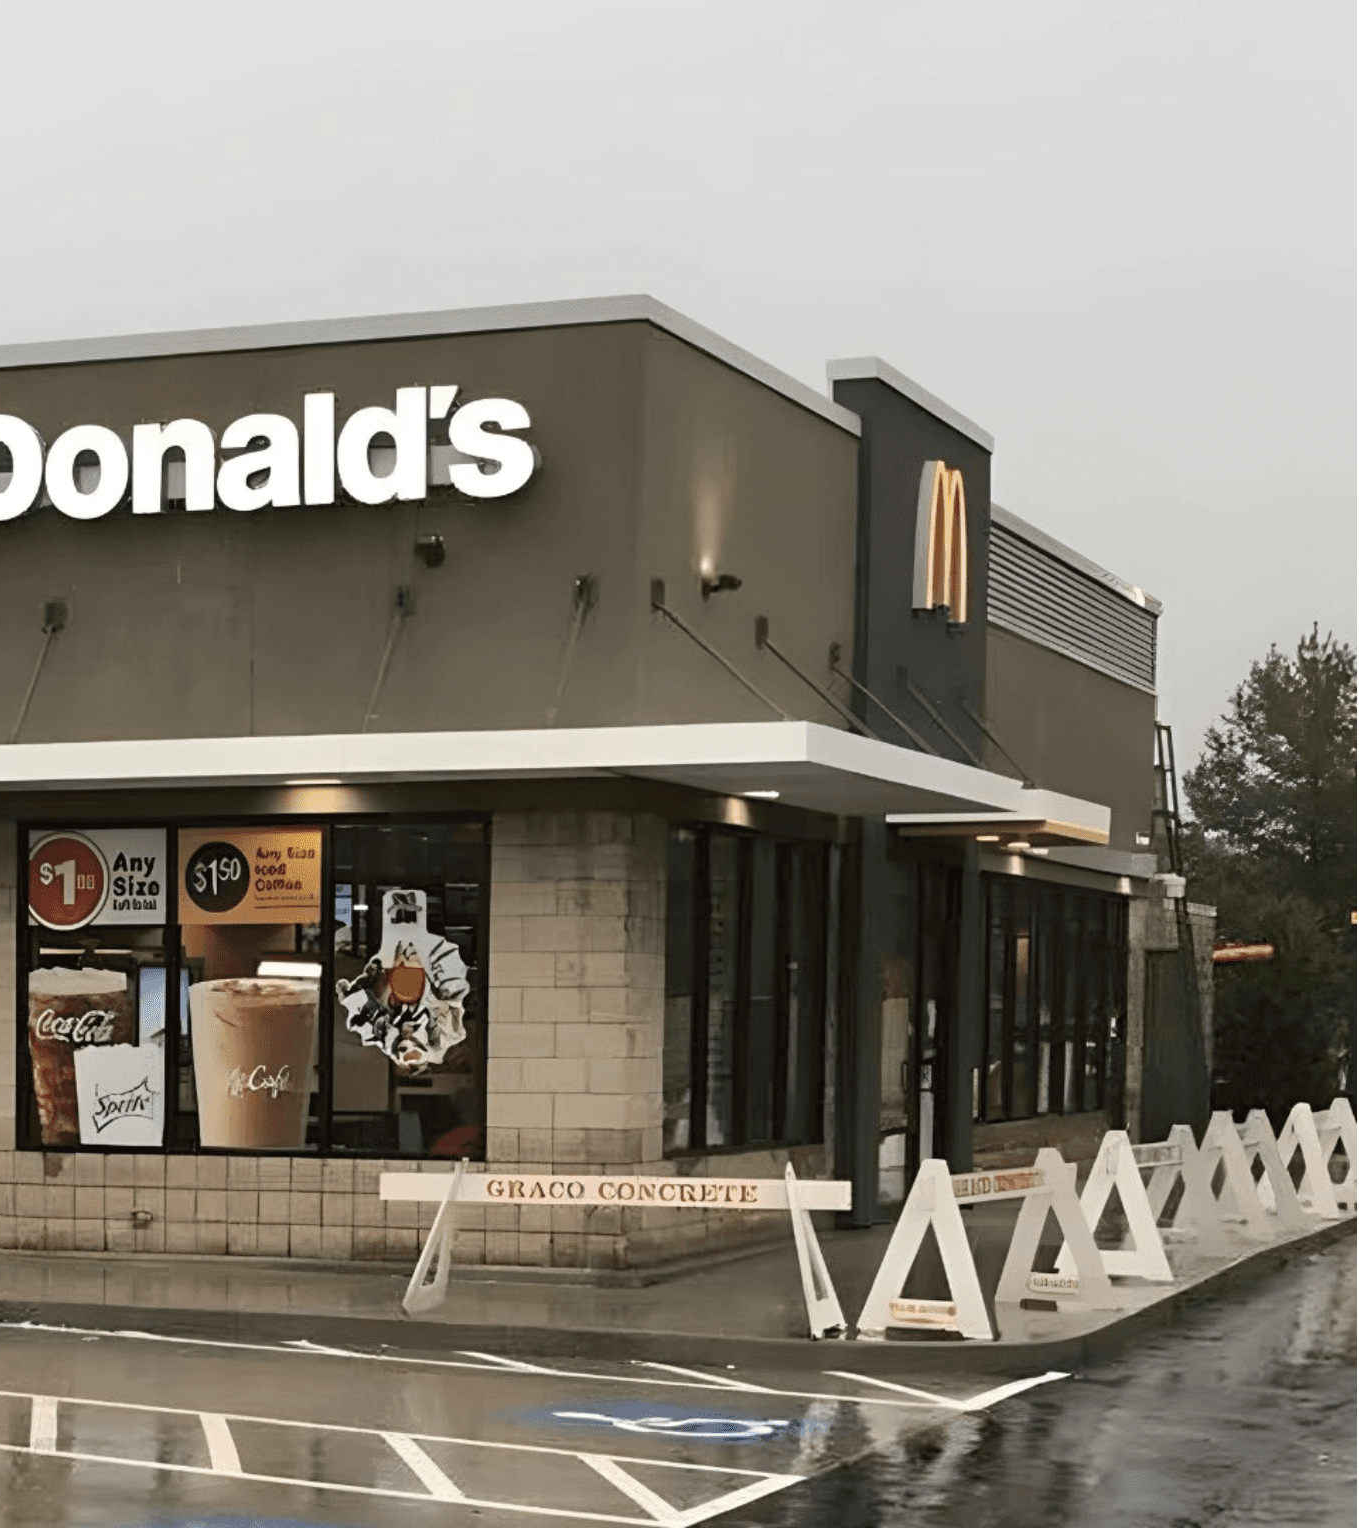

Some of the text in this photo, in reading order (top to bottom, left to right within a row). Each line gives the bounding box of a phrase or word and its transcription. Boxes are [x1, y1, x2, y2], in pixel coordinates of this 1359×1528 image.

[113, 850, 156, 878] Any
[486, 1179, 758, 1204] GRACO CONCRETE
